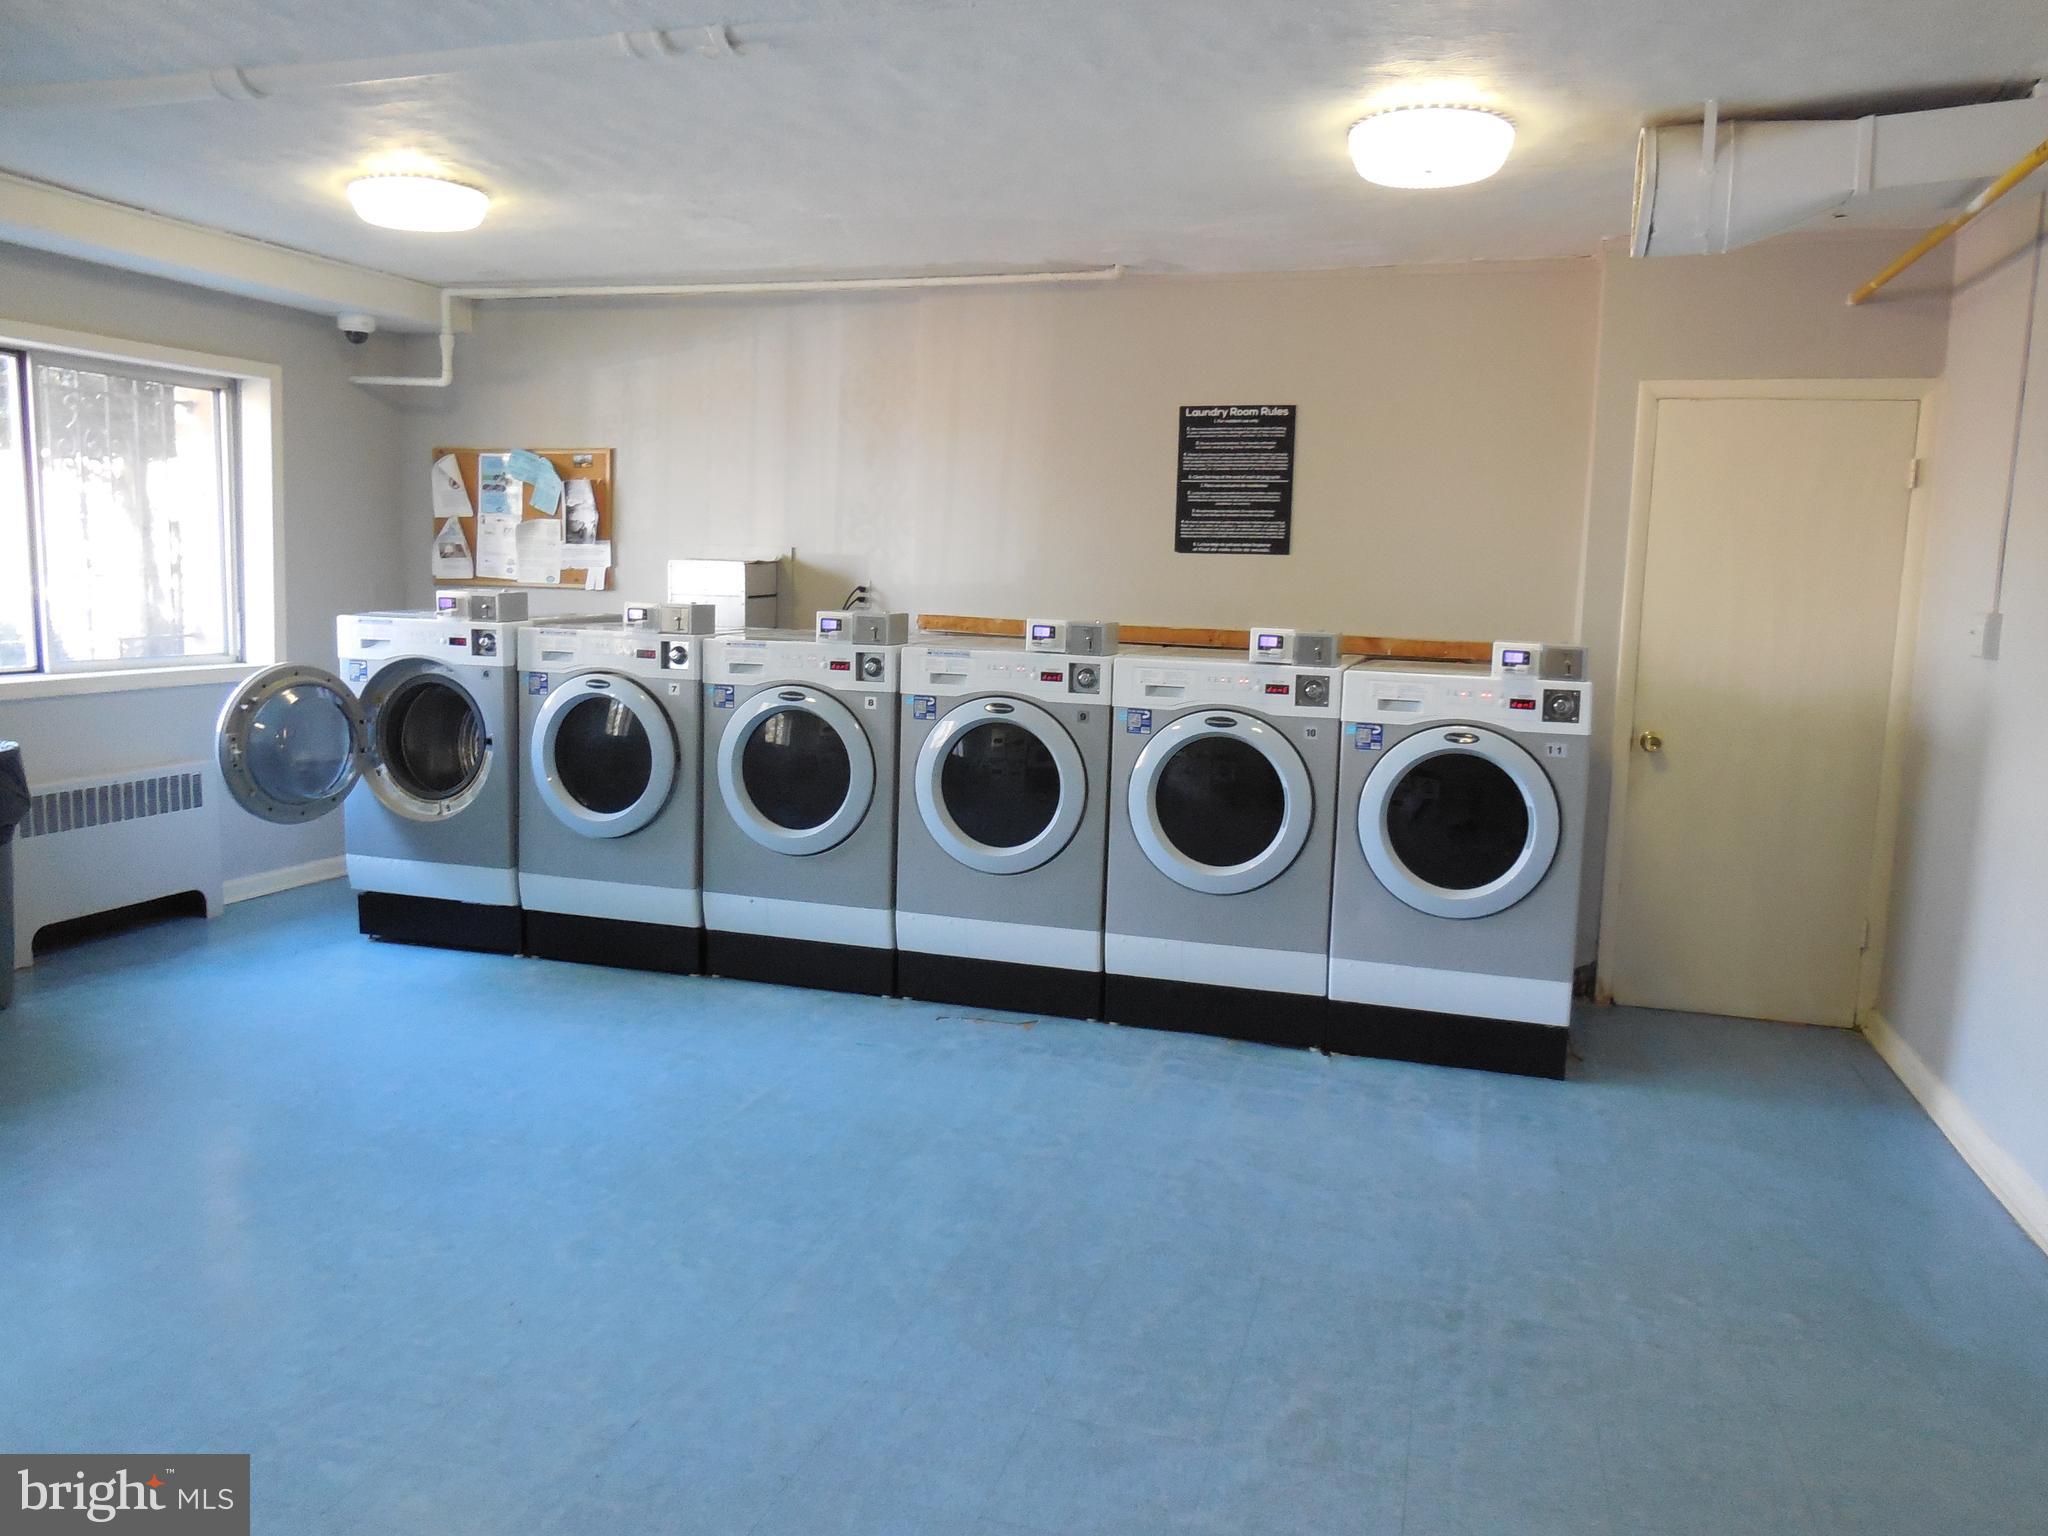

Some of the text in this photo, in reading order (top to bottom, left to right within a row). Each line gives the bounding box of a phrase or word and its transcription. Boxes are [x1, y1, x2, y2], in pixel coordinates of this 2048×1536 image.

[1185, 406, 1289, 419] Laundry Room Rules
[671, 685, 678, 693] 7
[867, 698, 875, 707] 8
[1079, 712, 1087, 721] 9
[1305, 728, 1317, 738] 10
